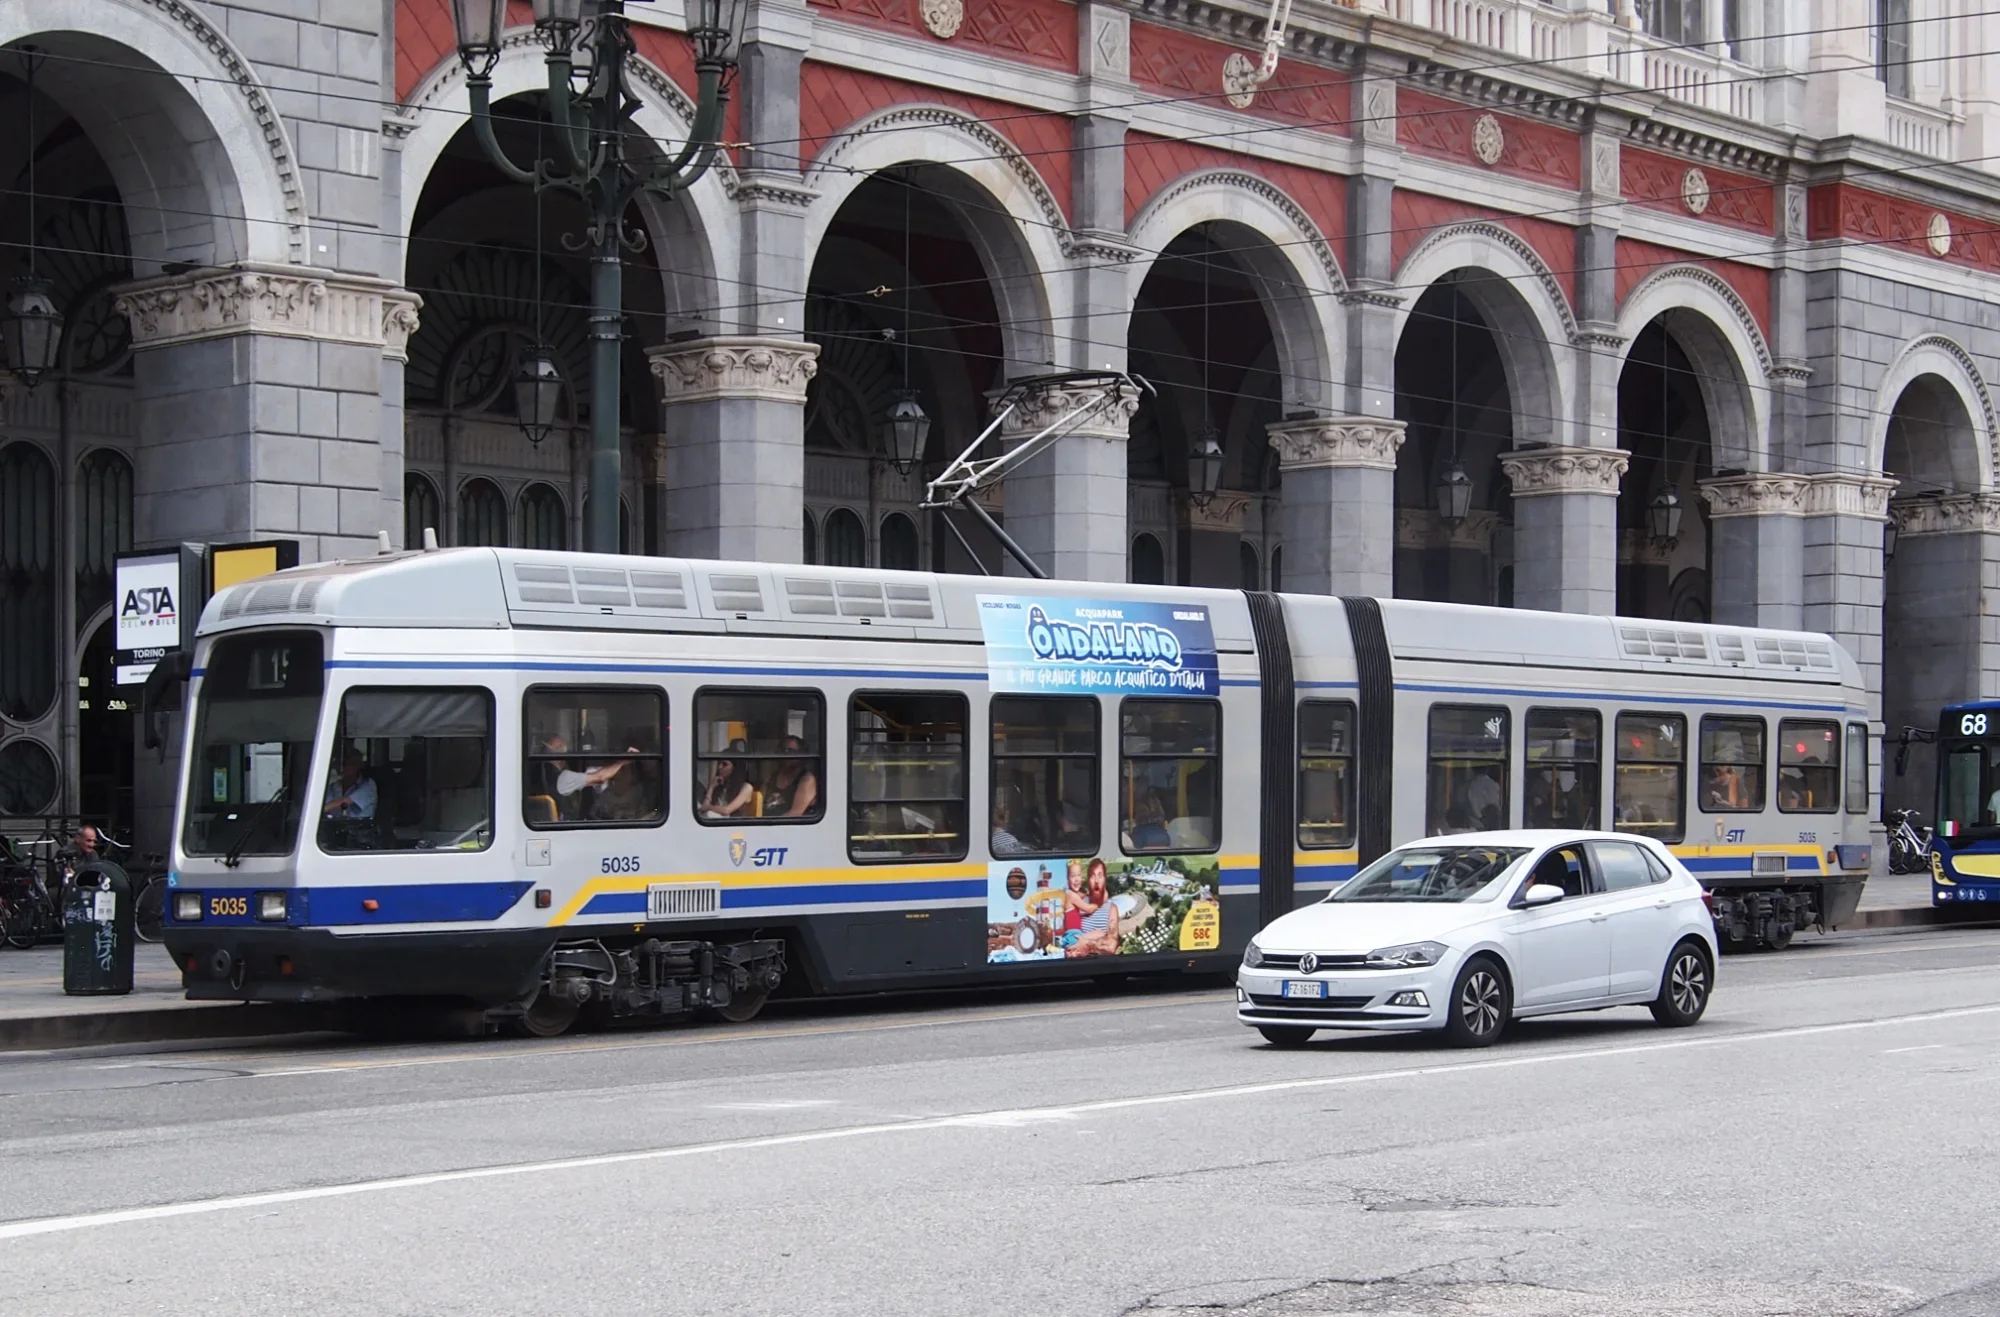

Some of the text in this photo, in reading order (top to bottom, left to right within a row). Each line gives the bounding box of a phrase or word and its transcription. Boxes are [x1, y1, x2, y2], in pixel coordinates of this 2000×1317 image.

[122, 587, 175, 616] ASTA
[1075, 608, 1124, 619] ACQUAPARK
[1028, 620, 1181, 668] ONDALAND
[133, 648, 165, 658] TORINO
[1039, 668, 1077, 688] GRANDE
[1081, 668, 1112, 688] PARCO
[1114, 669, 1166, 688] ACQUATICO
[1961, 714, 1987, 735] 68
[1798, 832, 1816, 842] 5035
[601, 856, 640, 873] 5035
[210, 897, 247, 915] 5035
[1193, 928, 1210, 939] 68€
